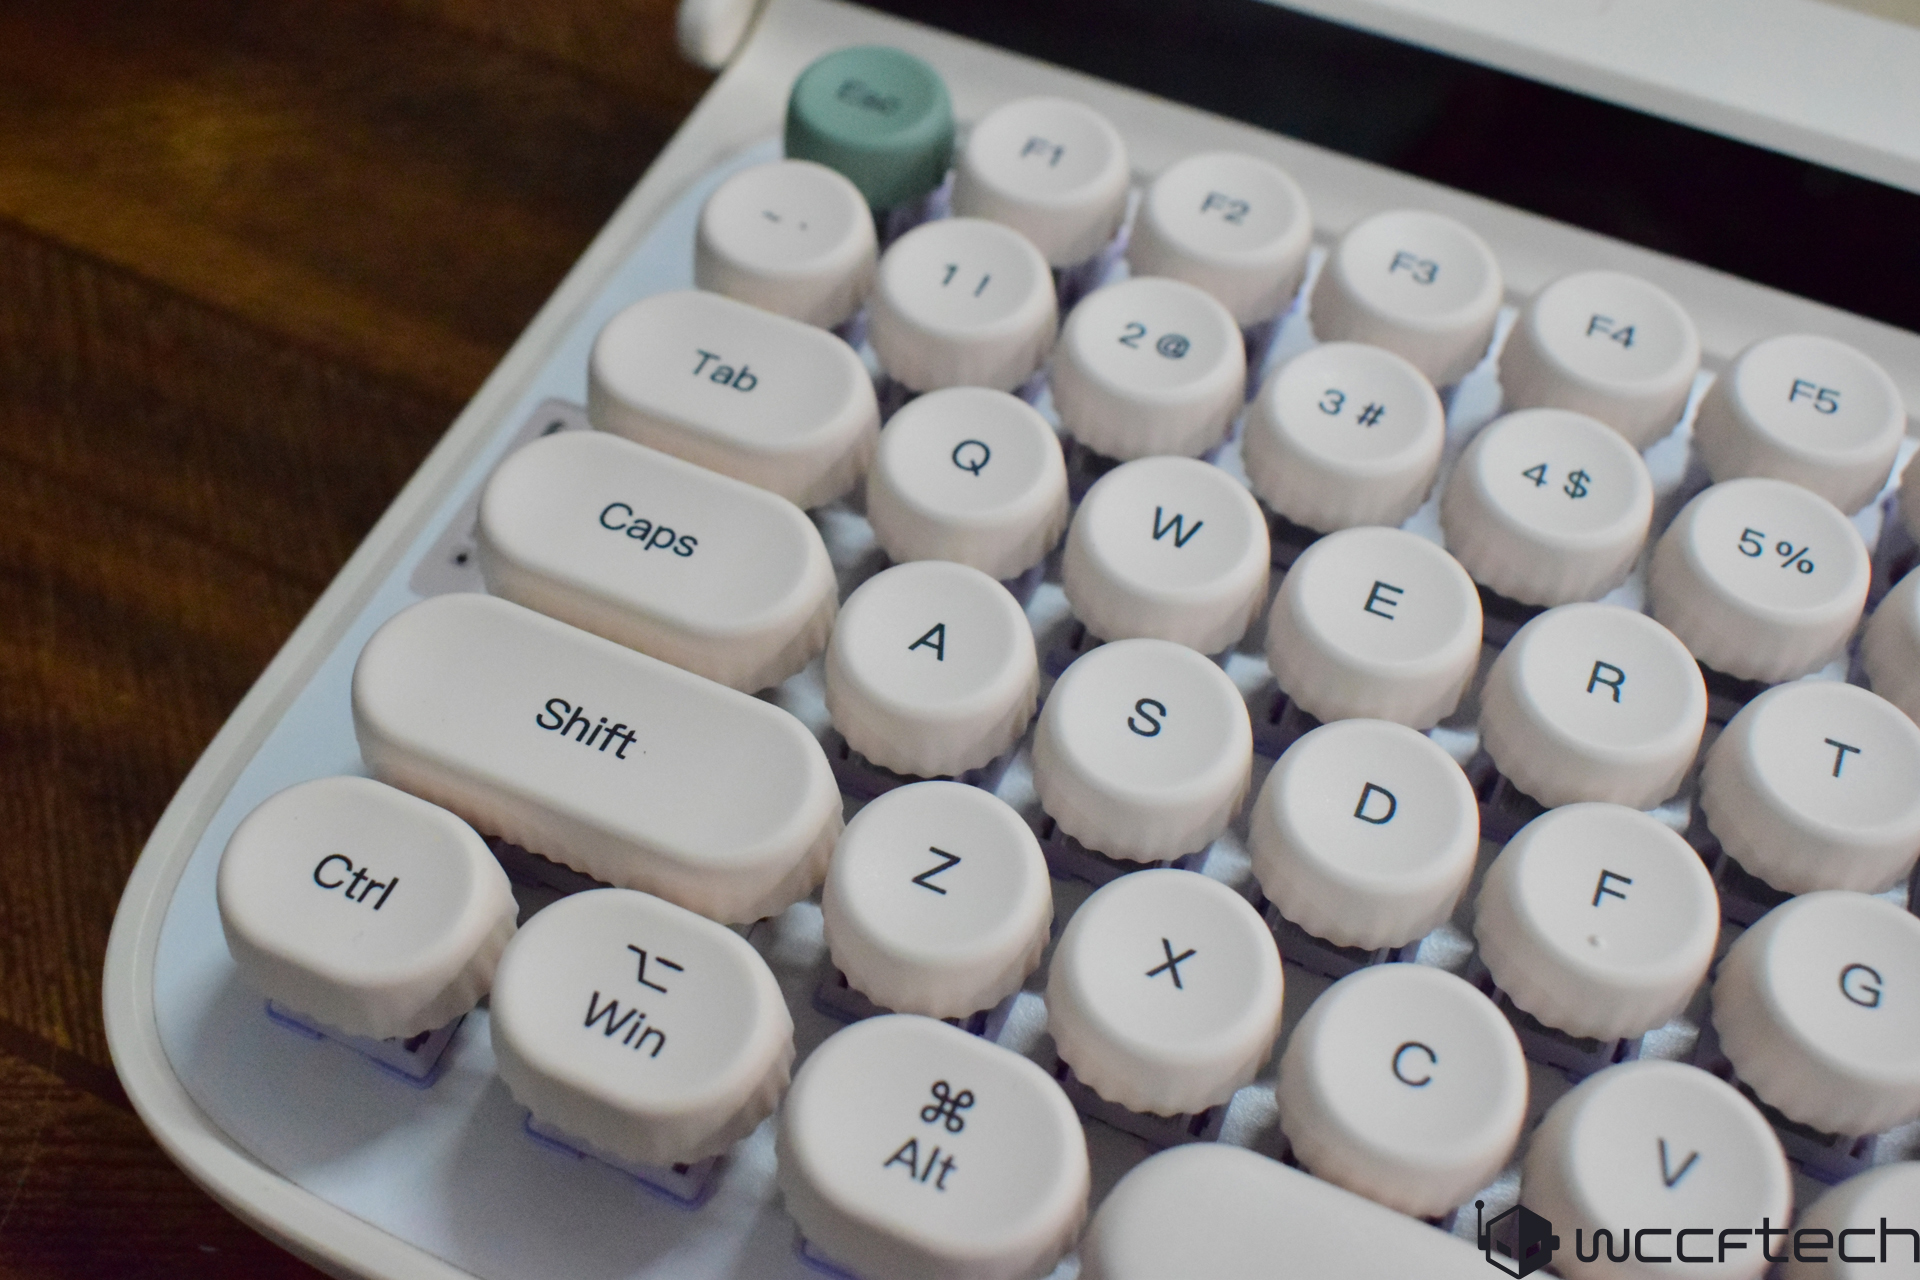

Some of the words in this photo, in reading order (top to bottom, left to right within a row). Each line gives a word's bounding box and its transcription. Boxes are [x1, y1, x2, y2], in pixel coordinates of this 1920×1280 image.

[836, 78, 902, 116] Esc
[1020, 136, 1066, 168] F1
[1199, 191, 1252, 225] F2
[941, 263, 959, 287] 1
[1388, 251, 1440, 286] F3
[1117, 321, 1148, 350] 2
[1154, 333, 1192, 361] @
[1585, 314, 1636, 350] F4
[693, 349, 759, 393] Tab
[1317, 388, 1347, 417] 3
[1356, 402, 1385, 428] #
[1787, 378, 1841, 416] F5
[951, 439, 991, 477] Q
[1521, 462, 1549, 489] 4
[1562, 468, 1592, 500] $
[599, 502, 699, 558] Caps
[1152, 506, 1204, 549] W
[1736, 526, 1766, 559] 5
[1774, 540, 1816, 576] %
[1363, 580, 1404, 621] E
[908, 622, 946, 662] A
[1586, 660, 1626, 704] R
[536, 697, 638, 760] Shift
[1127, 697, 1167, 738] S
[1824, 737, 1862, 778] T
[1353, 781, 1397, 825] D
[313, 853, 400, 911] Ctrl
[911, 846, 962, 895] Z
[1592, 869, 1633, 909] F
[1145, 937, 1197, 990] X
[1838, 963, 1883, 1009] G
[583, 989, 669, 1059] Win
[1391, 1041, 1437, 1088] C
[883, 1135, 959, 1191] Alt
[1657, 1138, 1700, 1189] V
